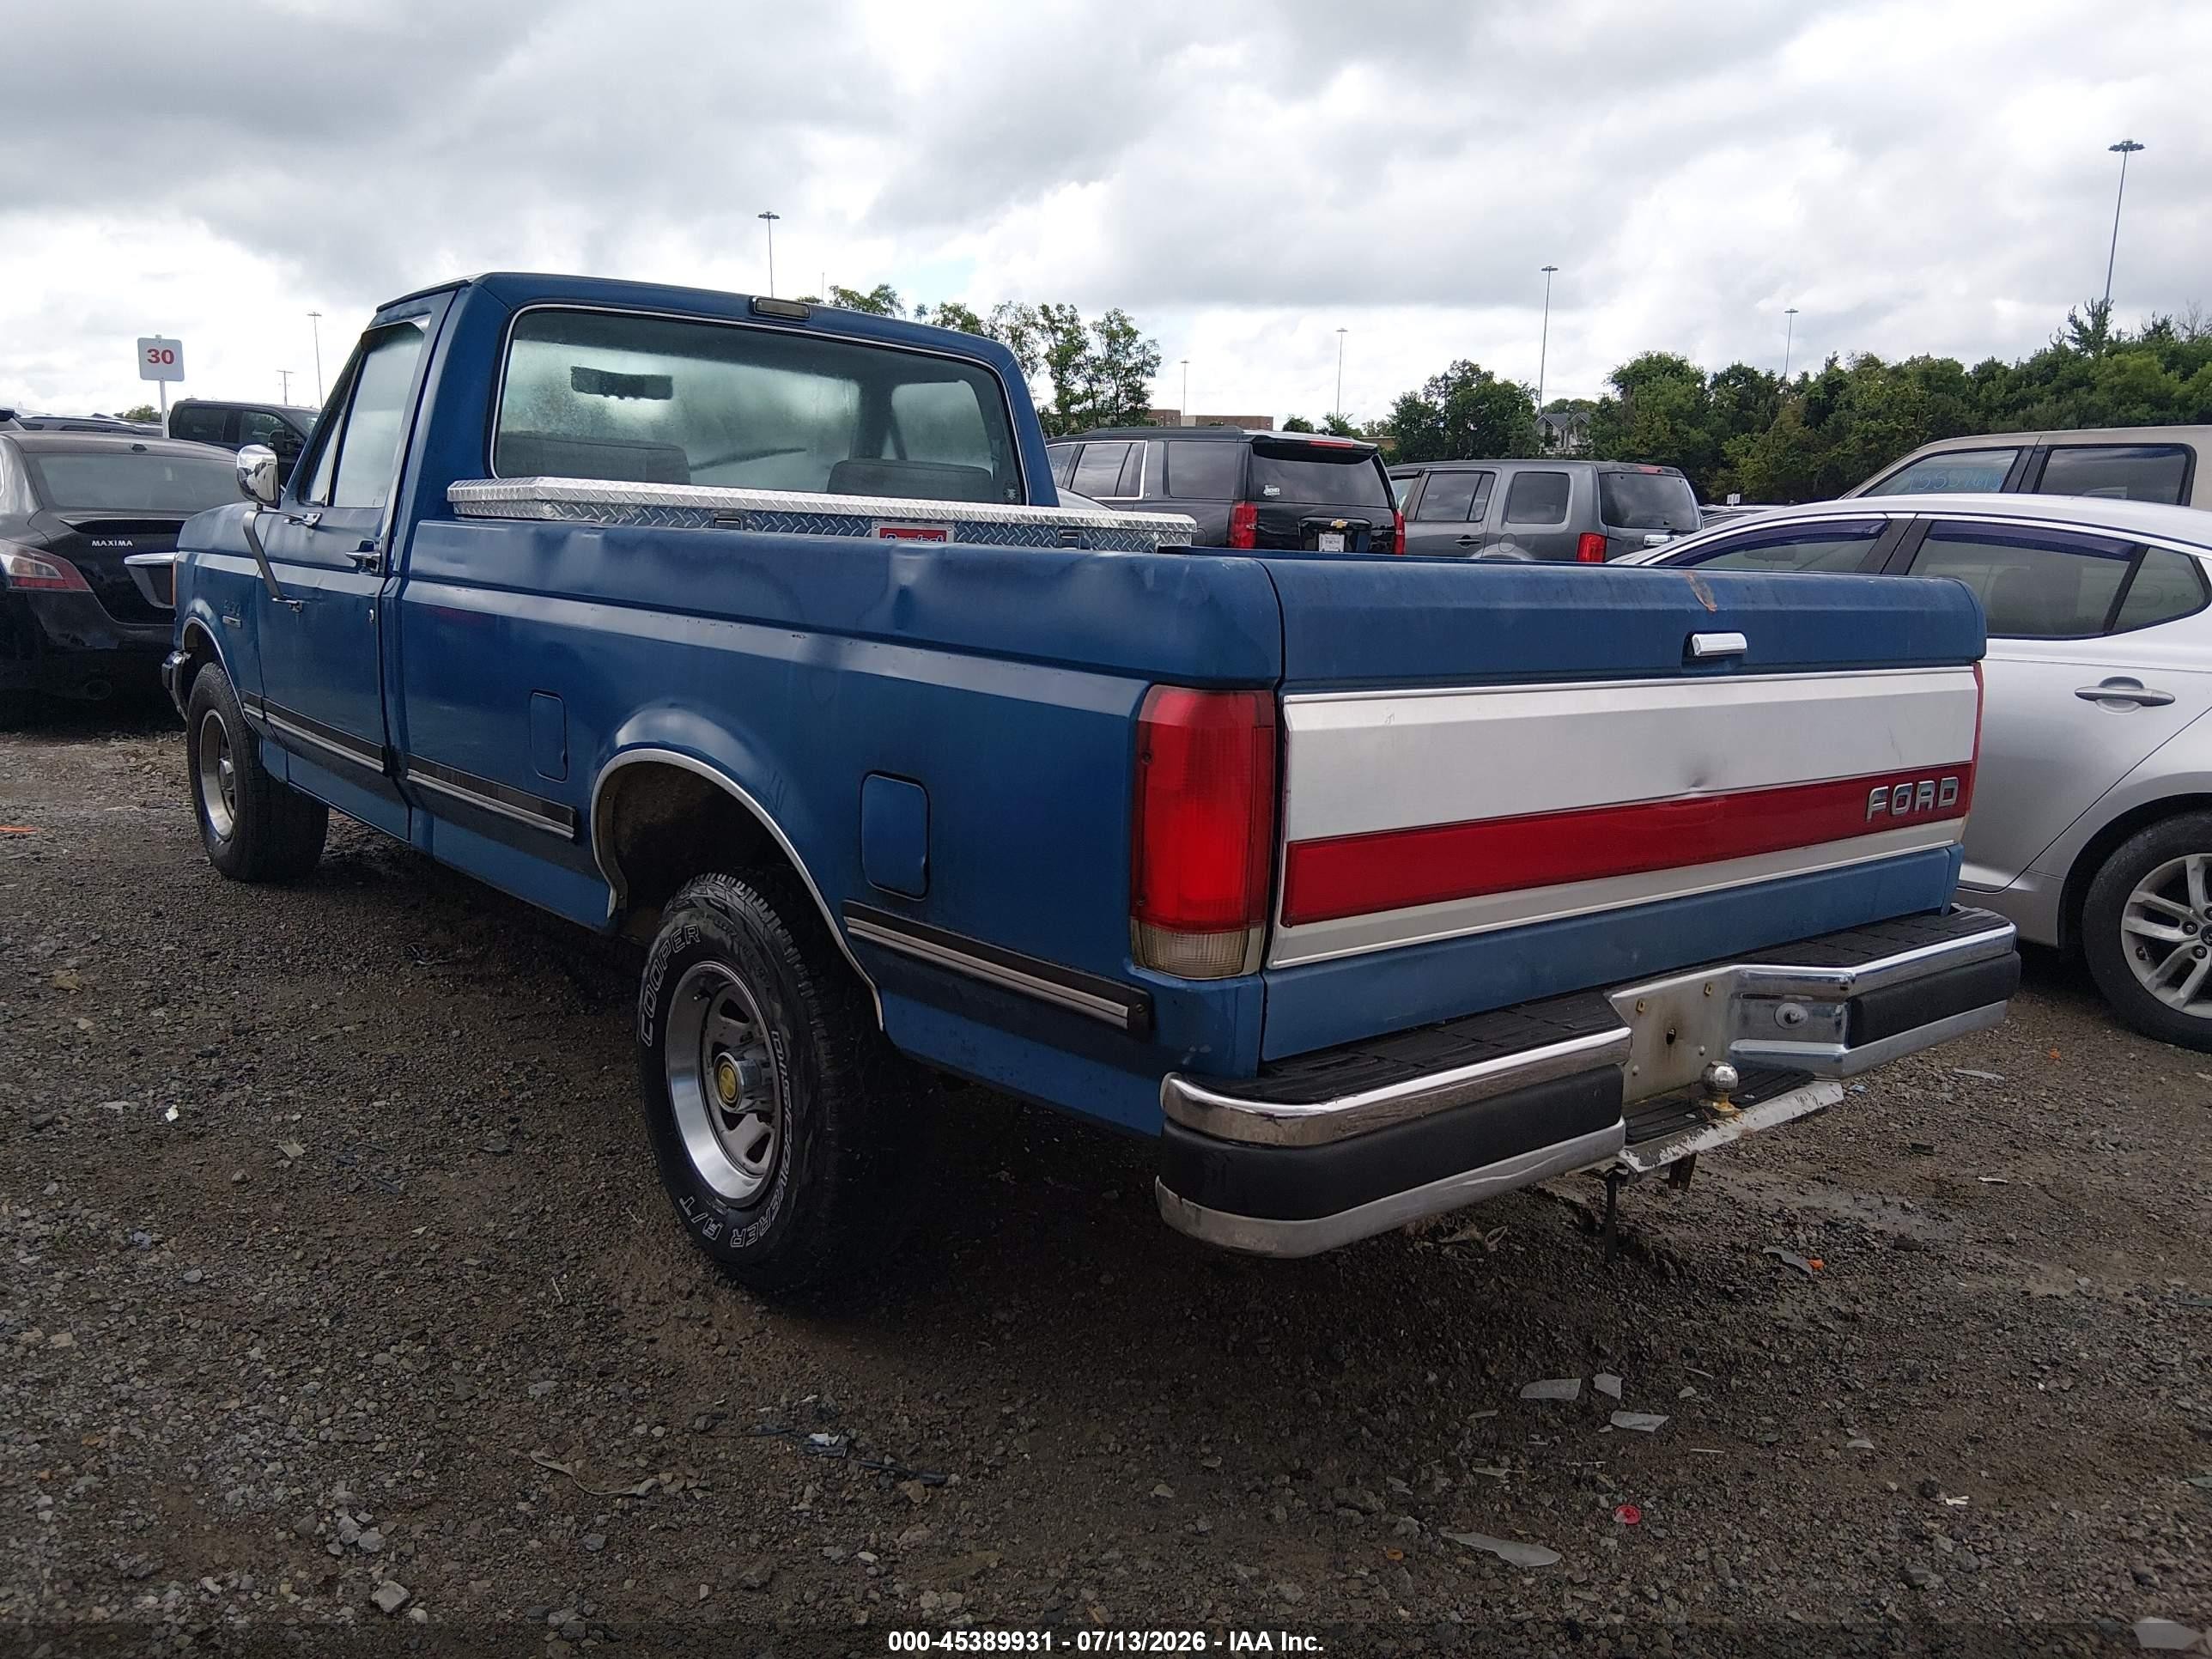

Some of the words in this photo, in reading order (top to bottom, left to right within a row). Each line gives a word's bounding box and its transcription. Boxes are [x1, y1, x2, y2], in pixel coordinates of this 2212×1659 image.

[146, 348, 174, 365] 30
[1865, 776, 1960, 823] FORD
[640, 923, 702, 1047] COOPER
[679, 1196, 724, 1241] A/T
